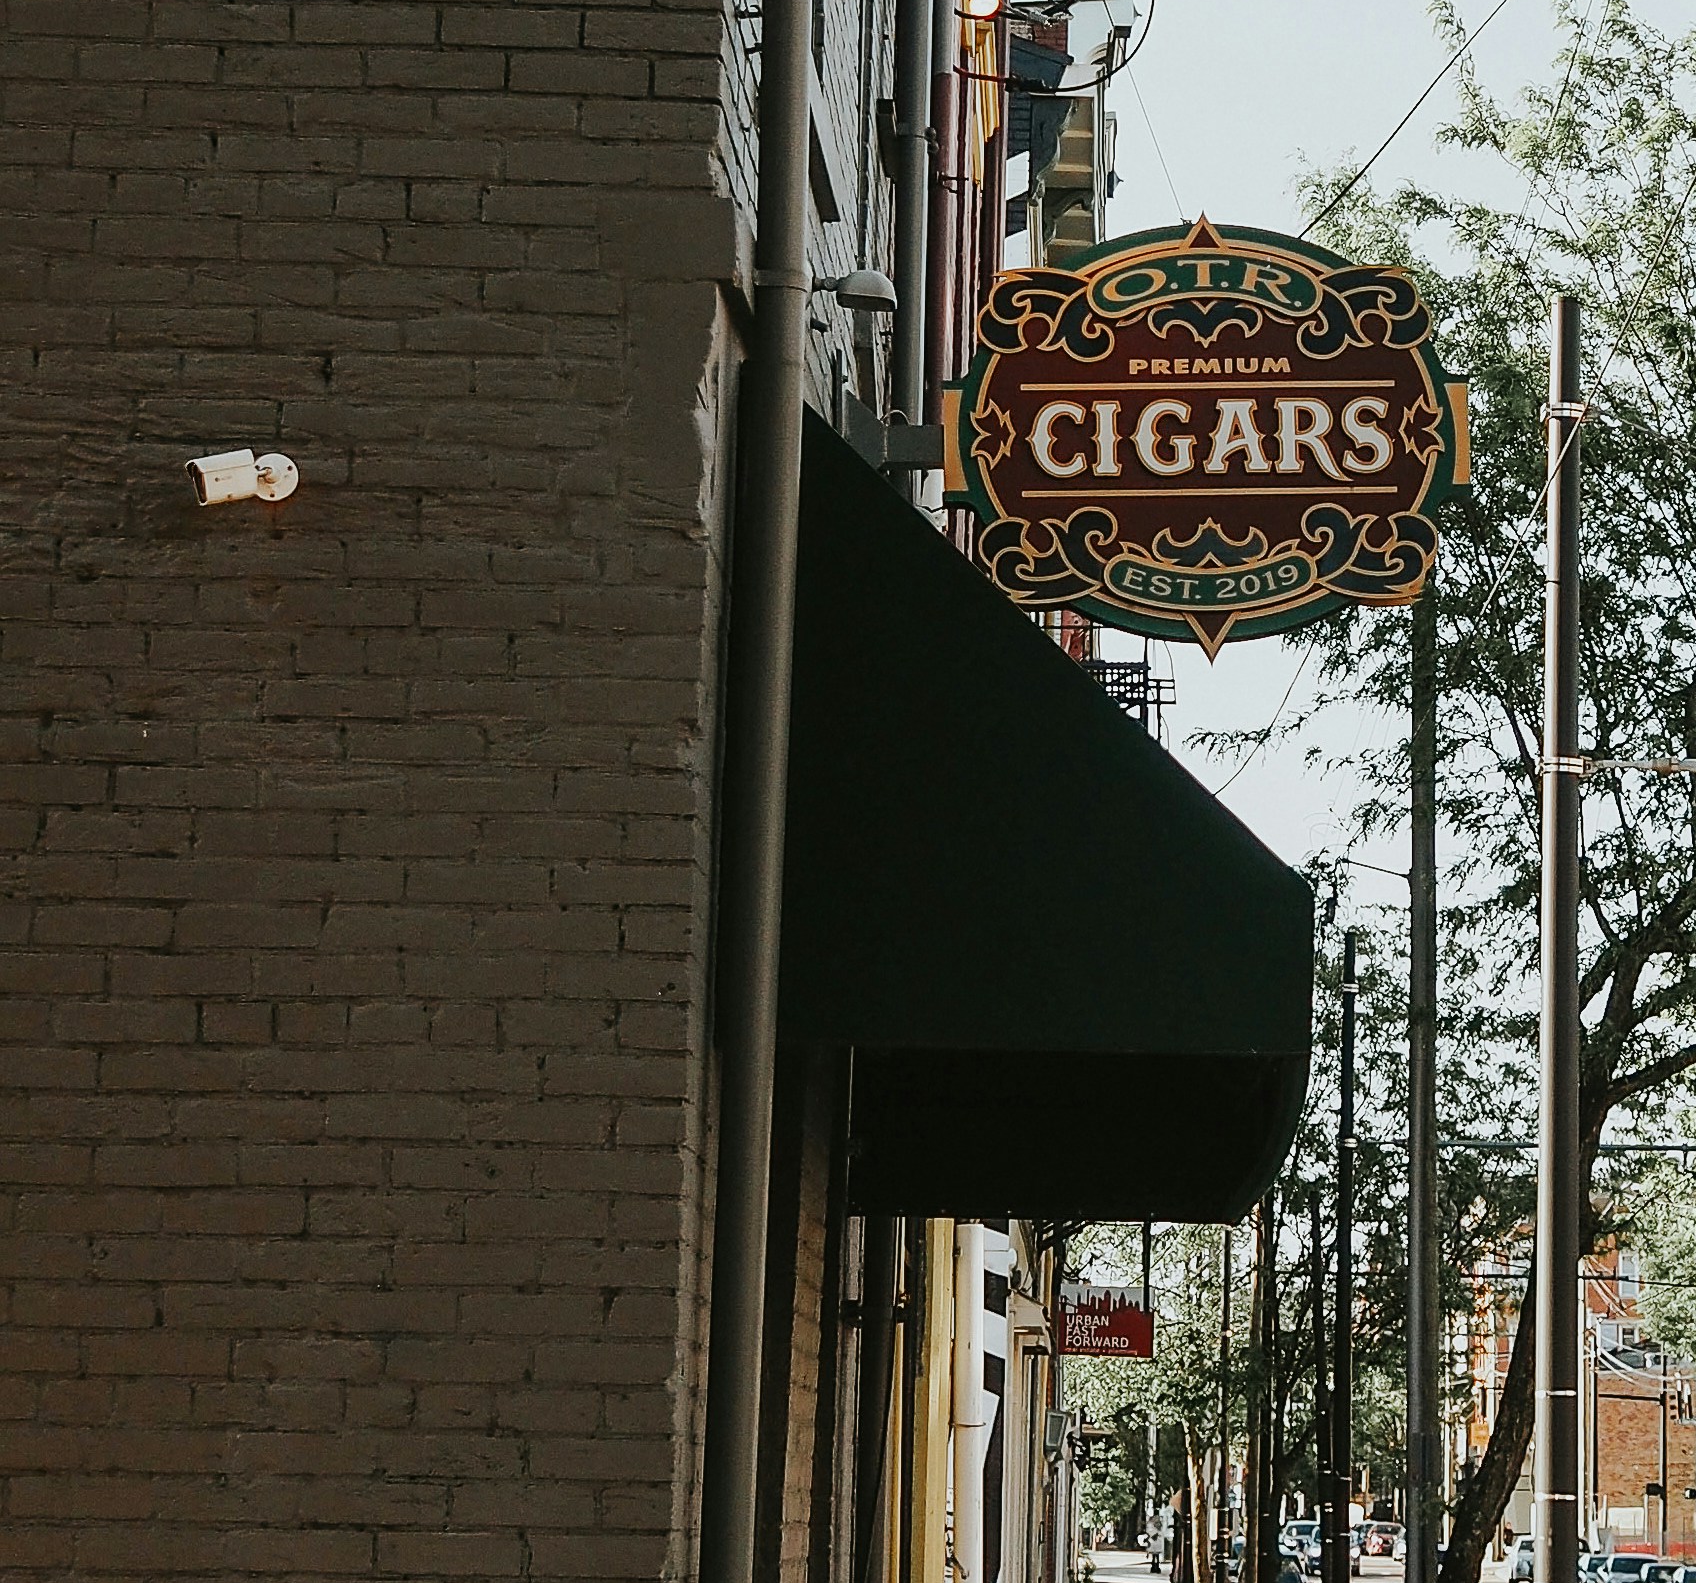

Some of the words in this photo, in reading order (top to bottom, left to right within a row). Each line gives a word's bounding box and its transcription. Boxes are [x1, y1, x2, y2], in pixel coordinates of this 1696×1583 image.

[1102, 258, 1303, 308] O.T.R.
[1128, 356, 1292, 375] PREMIUM
[1028, 396, 1395, 482] CIGARS
[1122, 565, 1200, 599] EST.
[1215, 563, 1300, 599] 2019
[1066, 1314, 1110, 1327] URBAN
[1066, 1325, 1098, 1337] FAST
[1065, 1335, 1129, 1348] FORWARD
